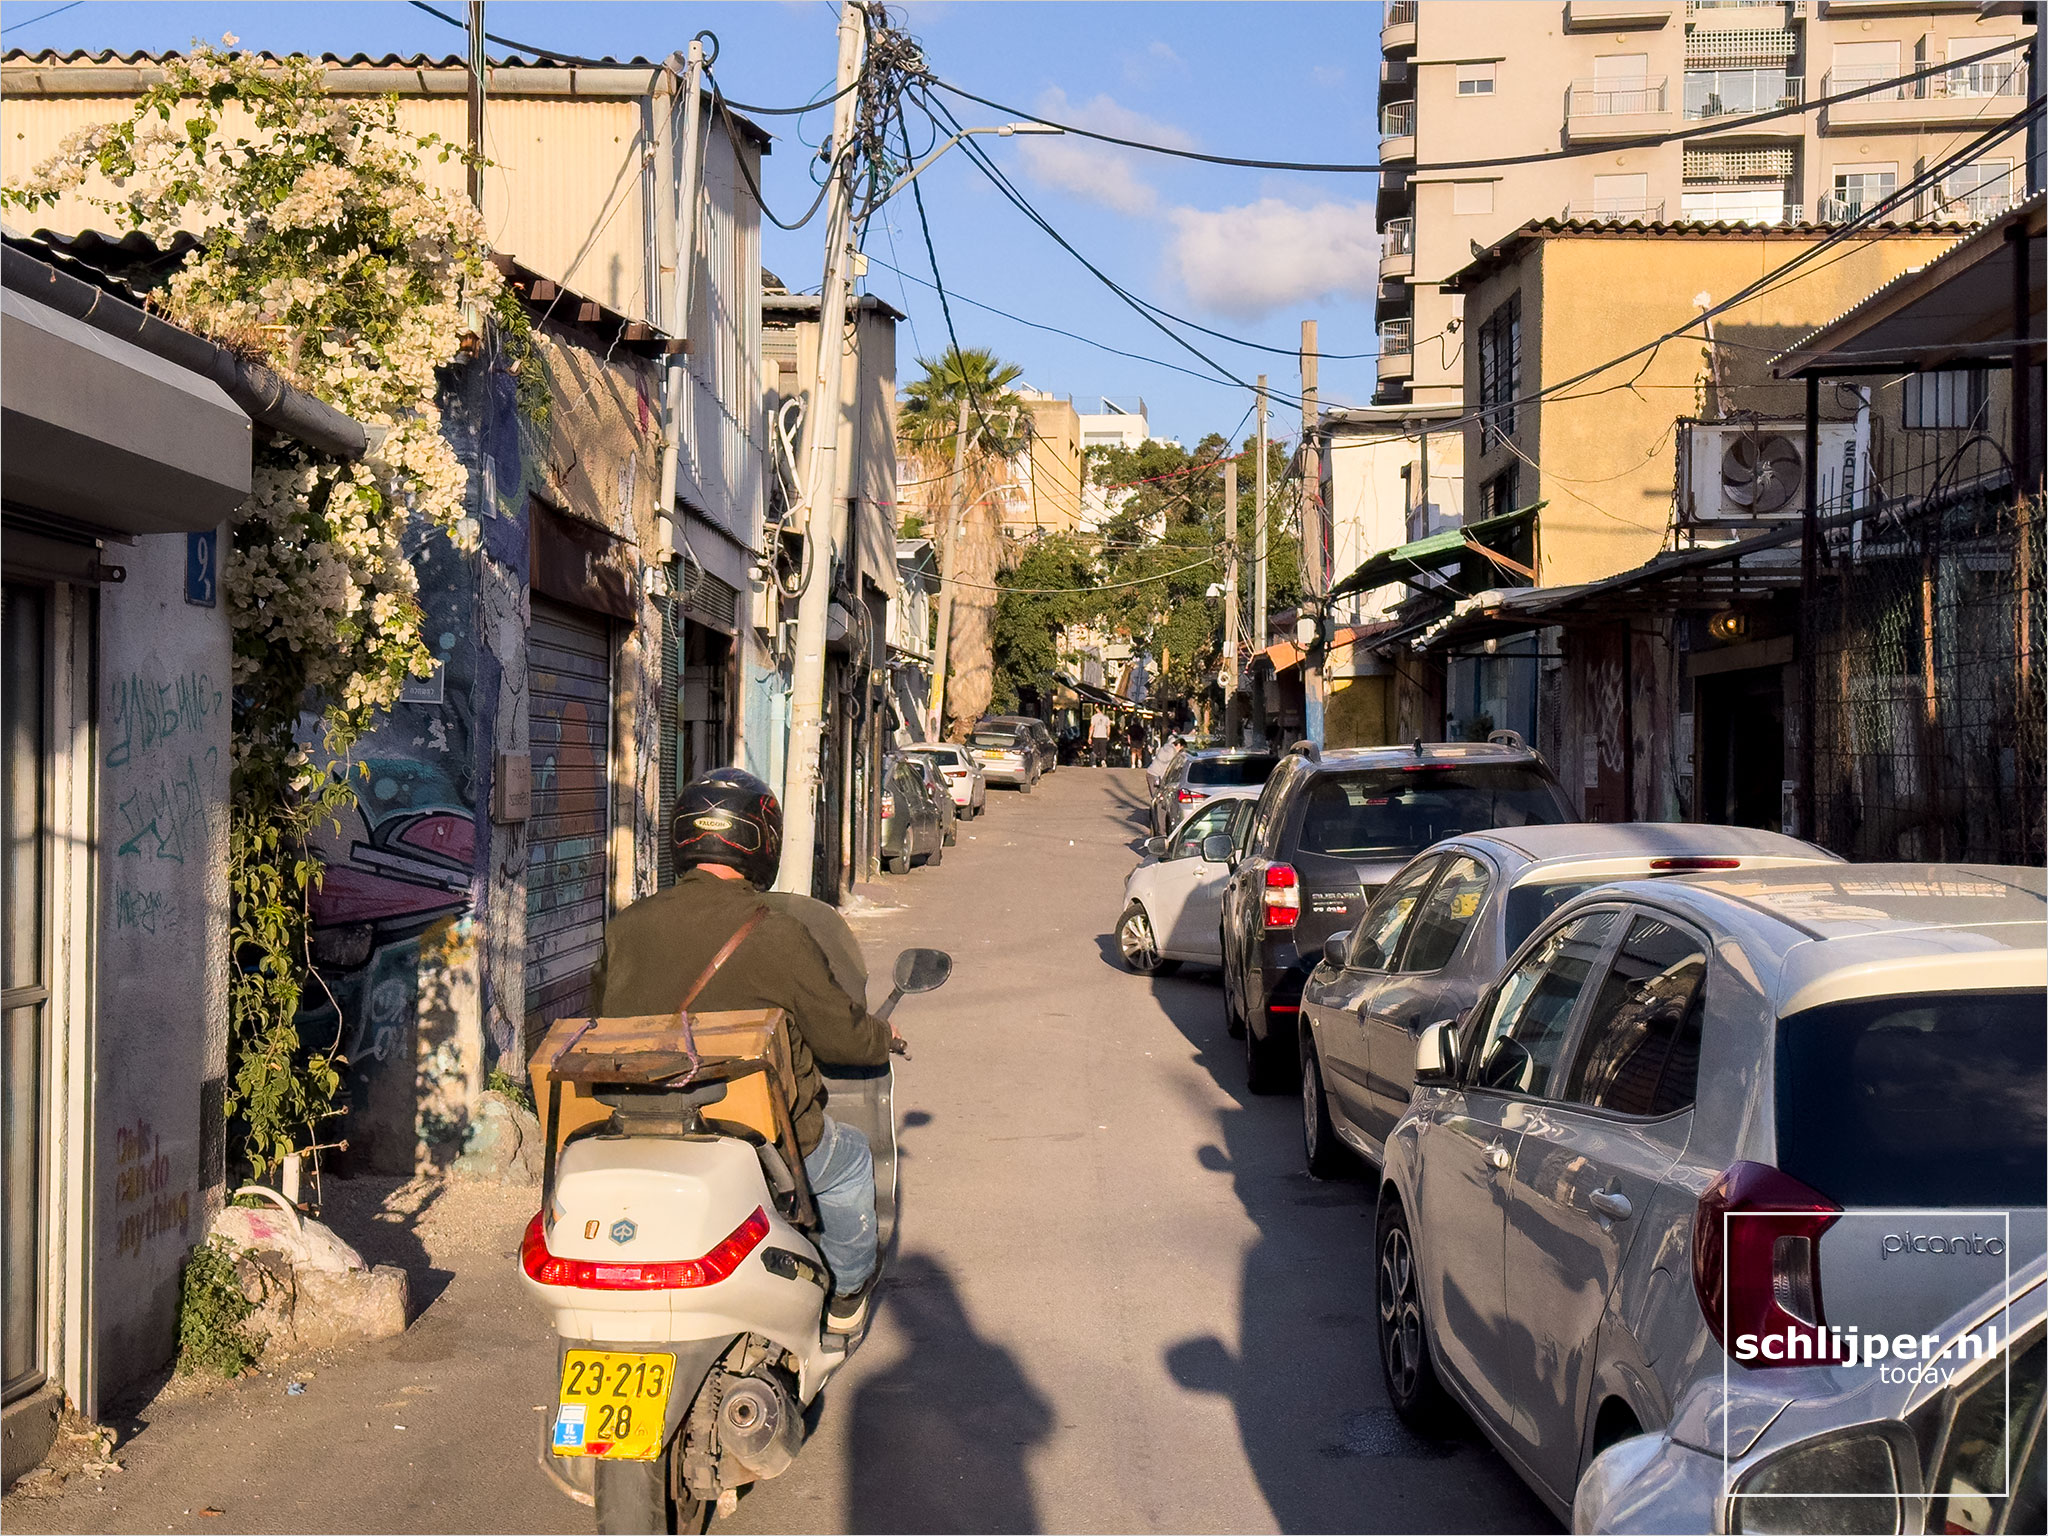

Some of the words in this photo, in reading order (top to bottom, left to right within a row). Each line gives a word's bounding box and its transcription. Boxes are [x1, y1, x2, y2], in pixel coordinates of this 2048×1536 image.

[1881, 1230, 2006, 1261] picanto
[565, 1423, 576, 1435] IL
[597, 1404, 632, 1440] 28
